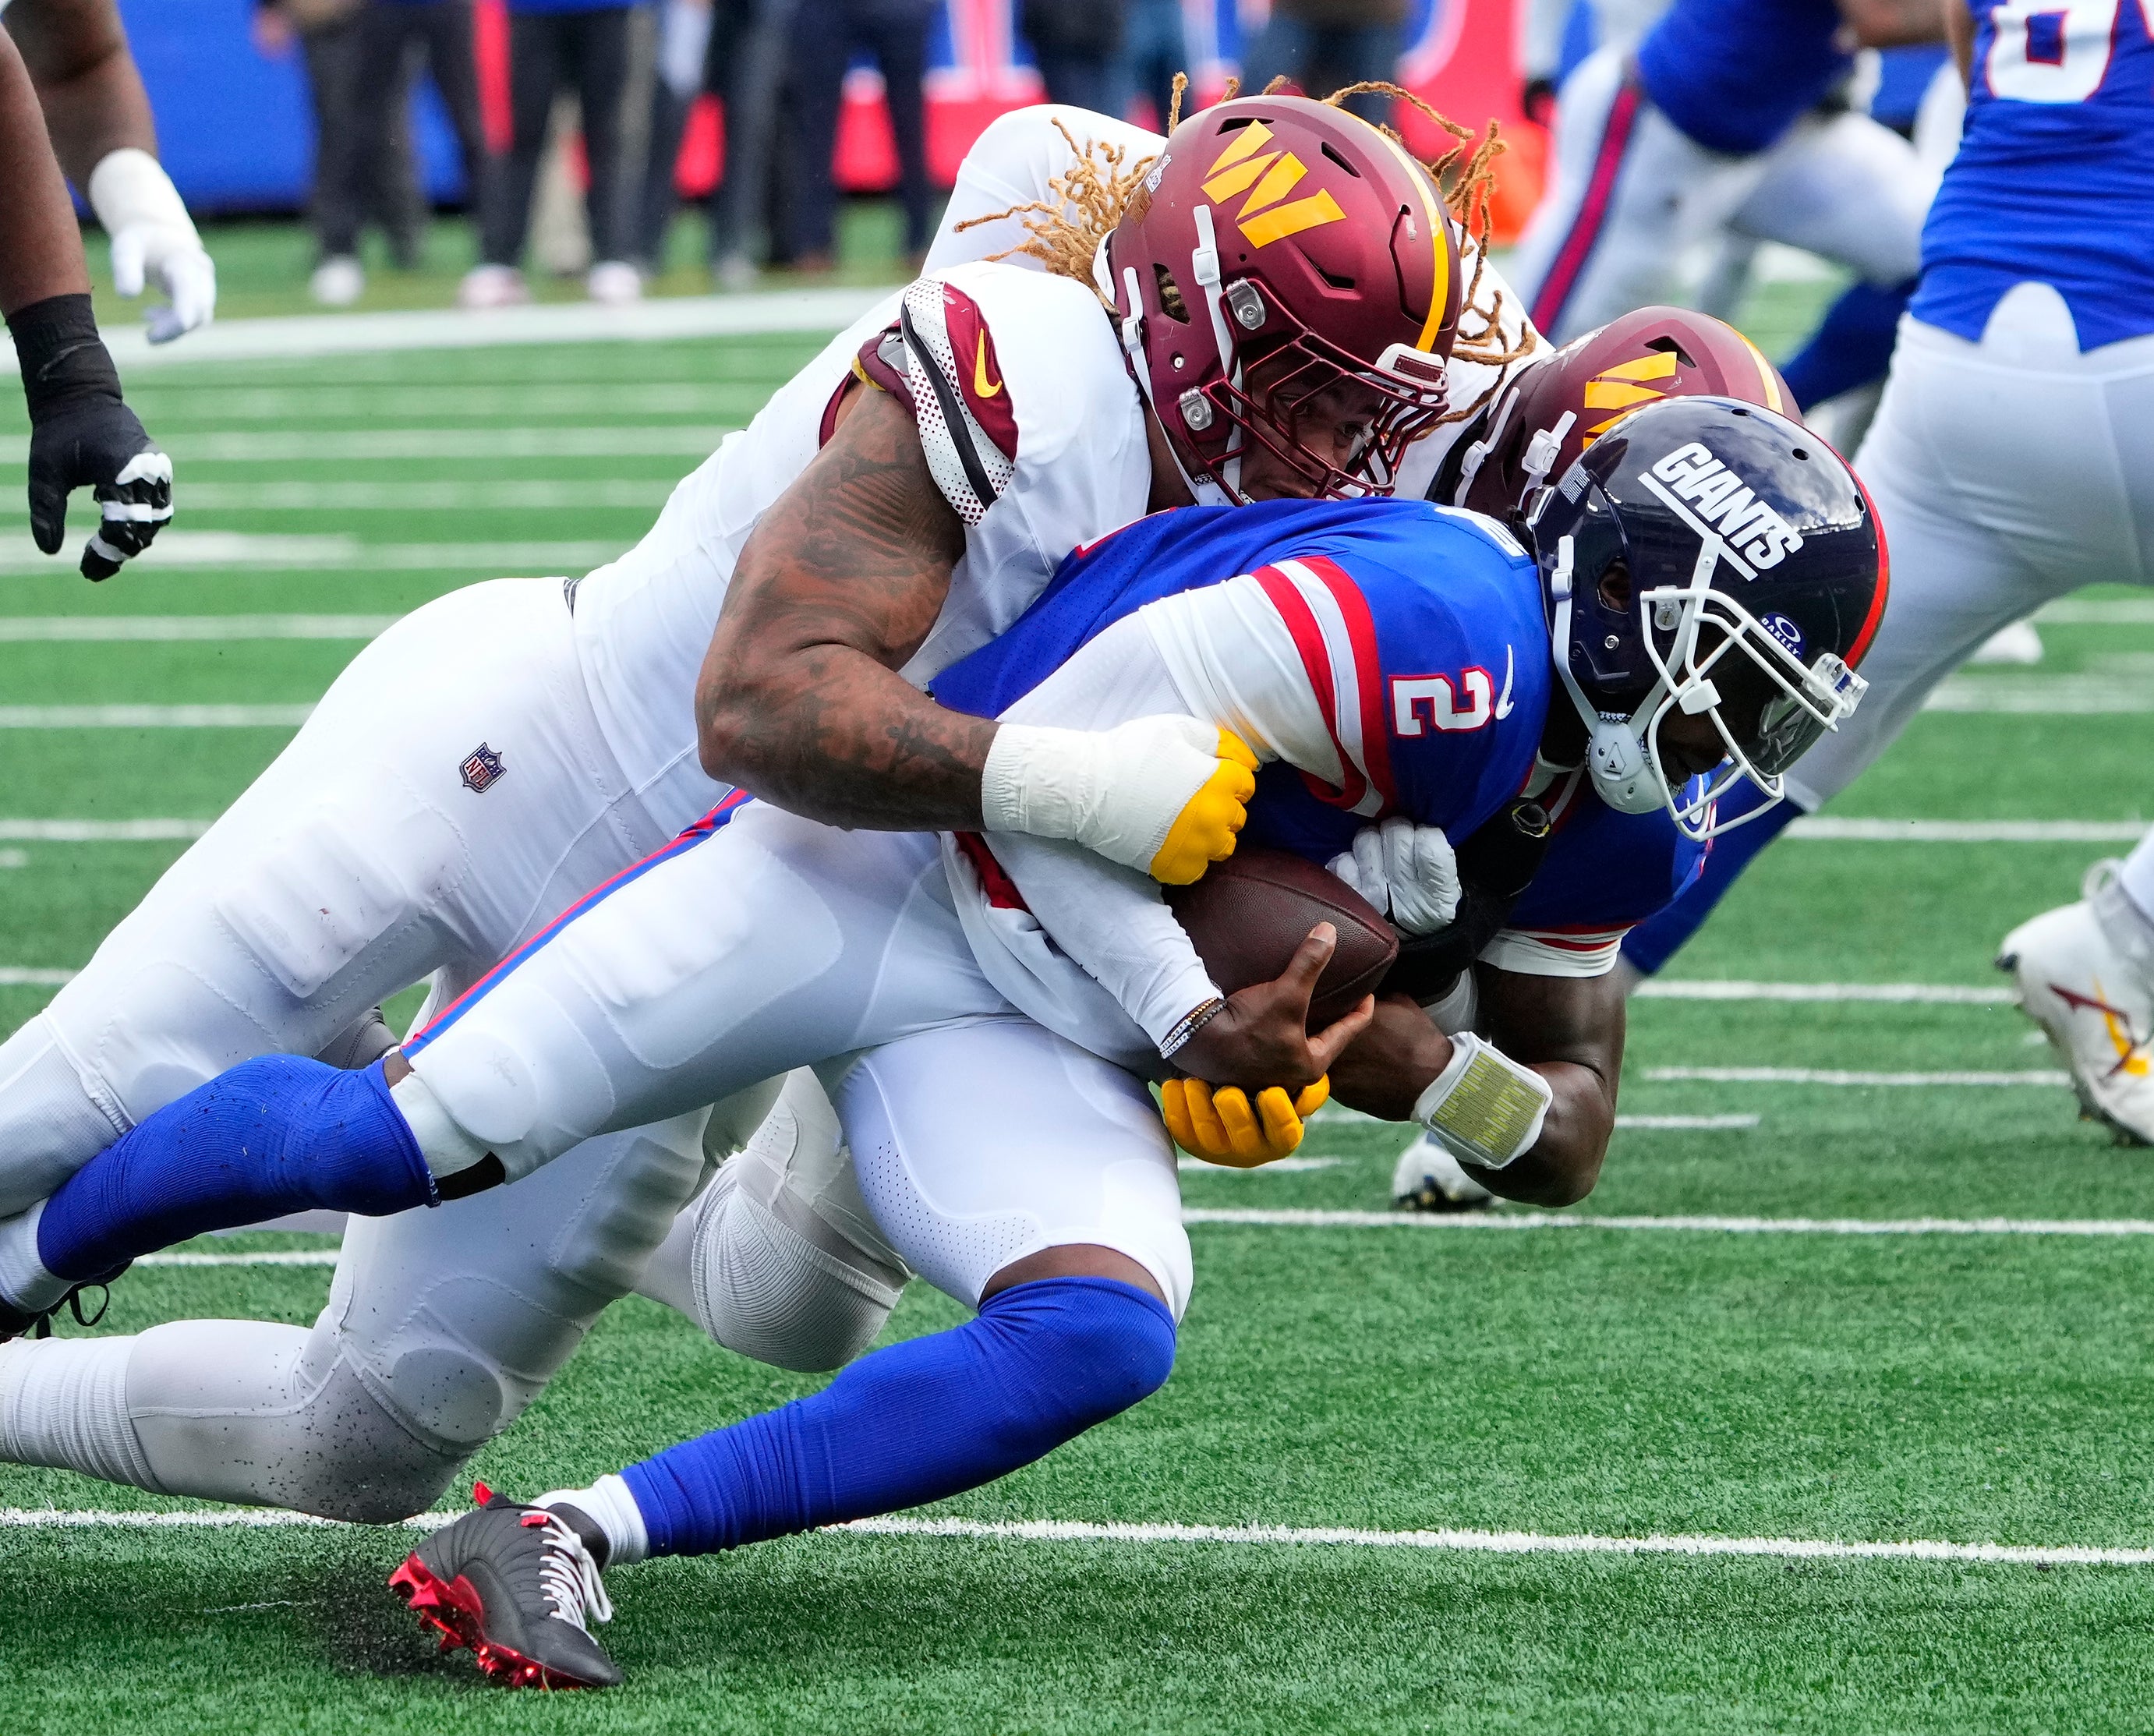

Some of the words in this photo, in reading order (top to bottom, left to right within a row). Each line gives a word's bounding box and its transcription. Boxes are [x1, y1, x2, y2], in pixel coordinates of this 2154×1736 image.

[1652, 442, 1804, 570] GIANTS
[1761, 617, 1799, 655] OAKLEY
[1389, 665, 1494, 739] 2
[465, 758, 490, 787] NFL
